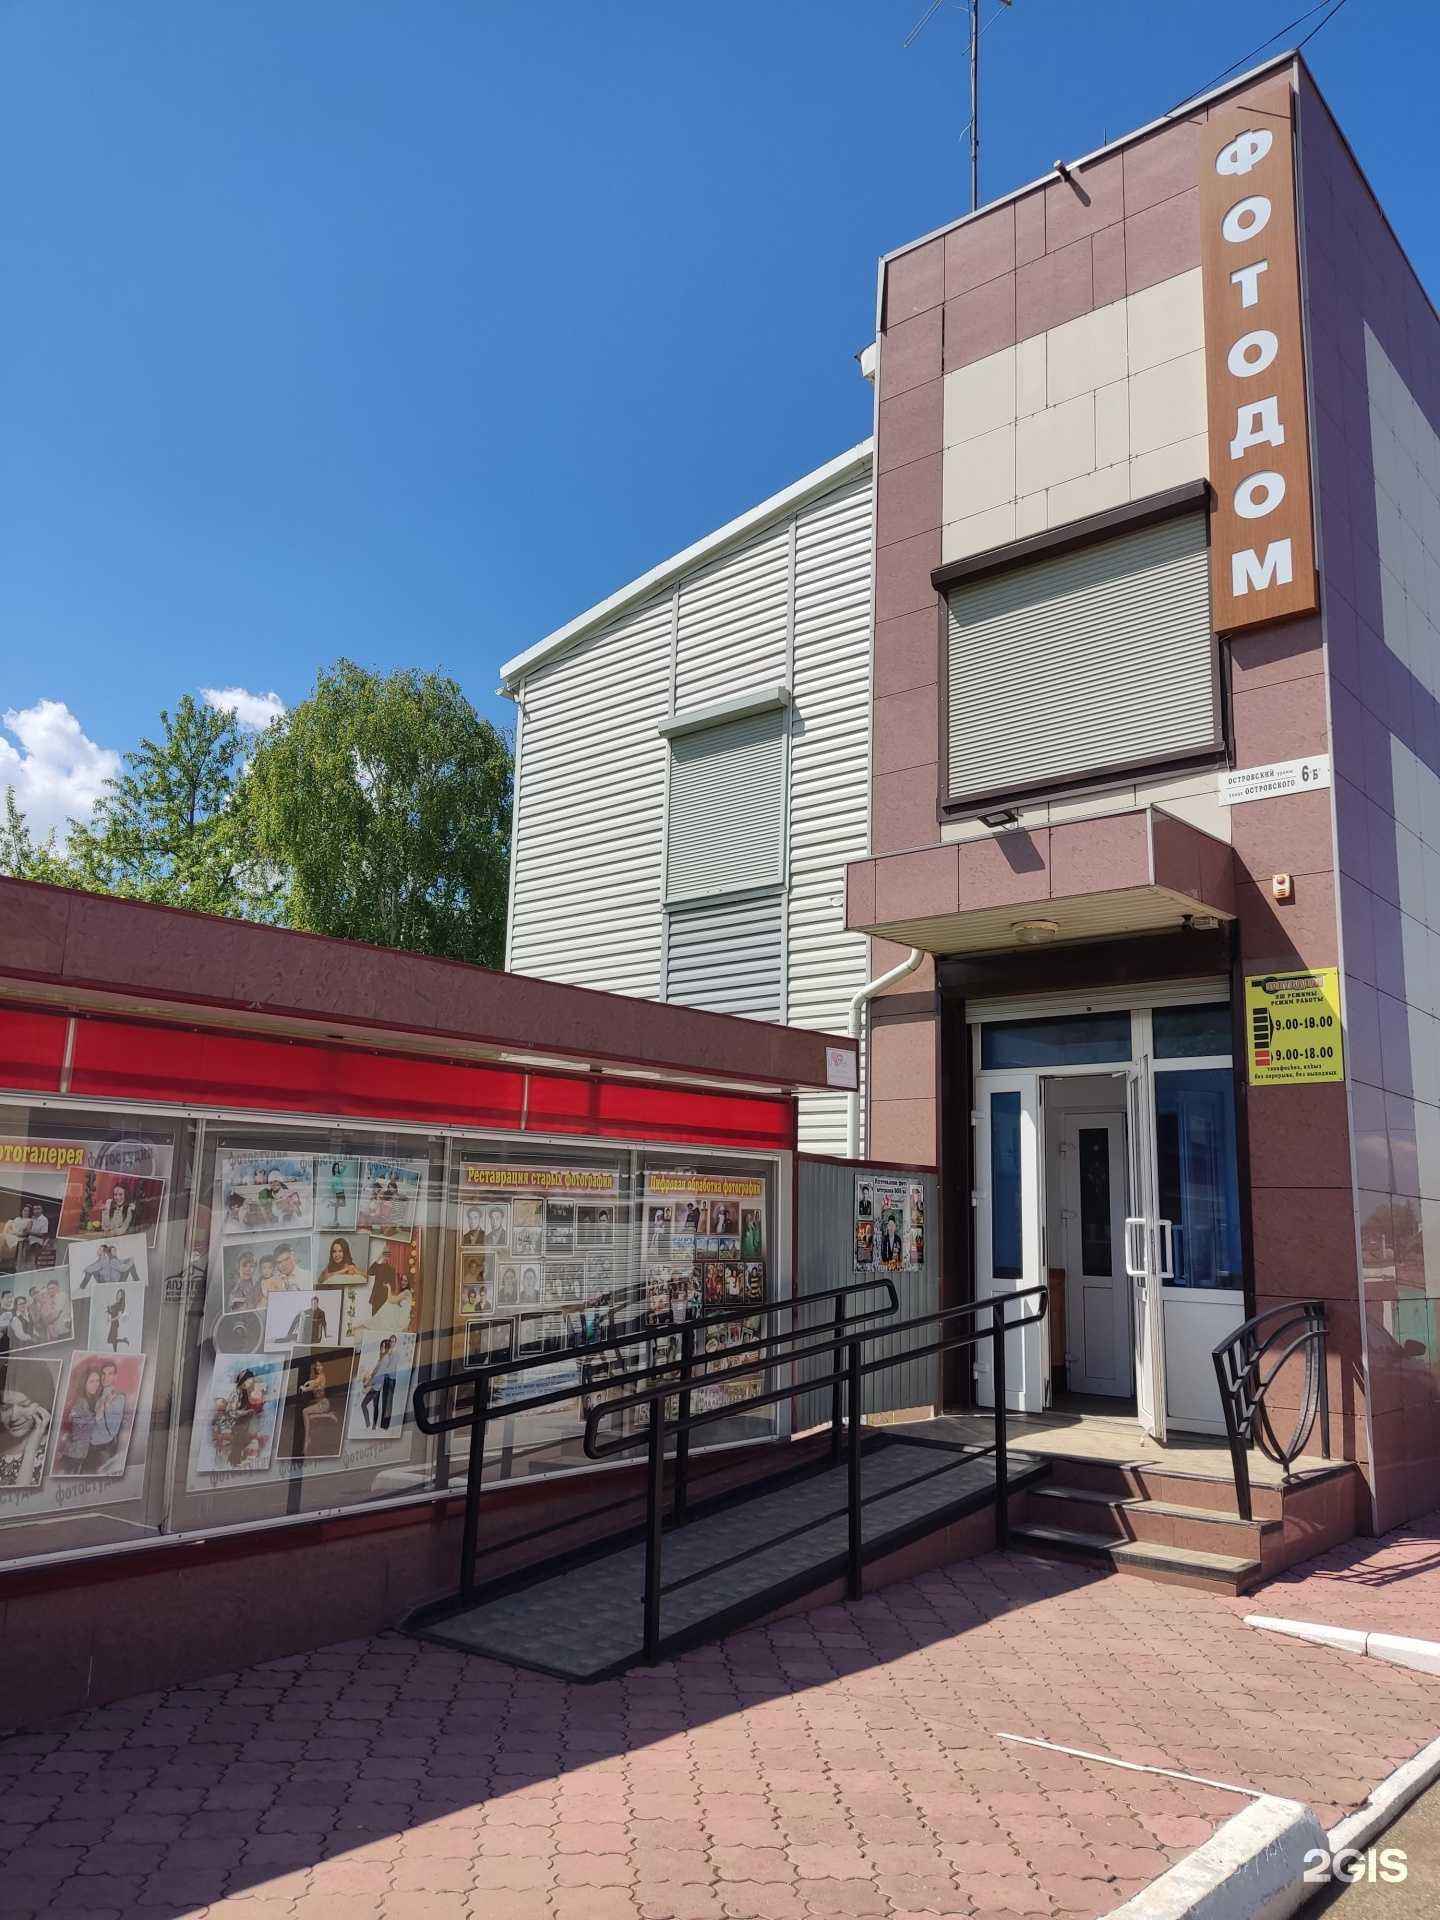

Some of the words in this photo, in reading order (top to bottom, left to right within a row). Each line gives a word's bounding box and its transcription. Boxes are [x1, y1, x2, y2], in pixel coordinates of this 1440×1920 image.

[1215, 128, 1292, 597] ФОТОДОМ
[1228, 769, 1275, 785] ОСТРОВСКИЙ
[1245, 780, 1295, 795] ОСТРОВСКОГО
[1296, 996, 1324, 1004] РАБОТЫ
[1275, 1015, 1333, 1031] 9.00-18.00
[1275, 1046, 1334, 1061] 9.00-18.00
[468, 1167, 529, 1189] Реставрация
[531, 1171, 562, 1189] старых
[650, 1175, 686, 1194] Цифровая
[687, 1176, 722, 1194] обработка
